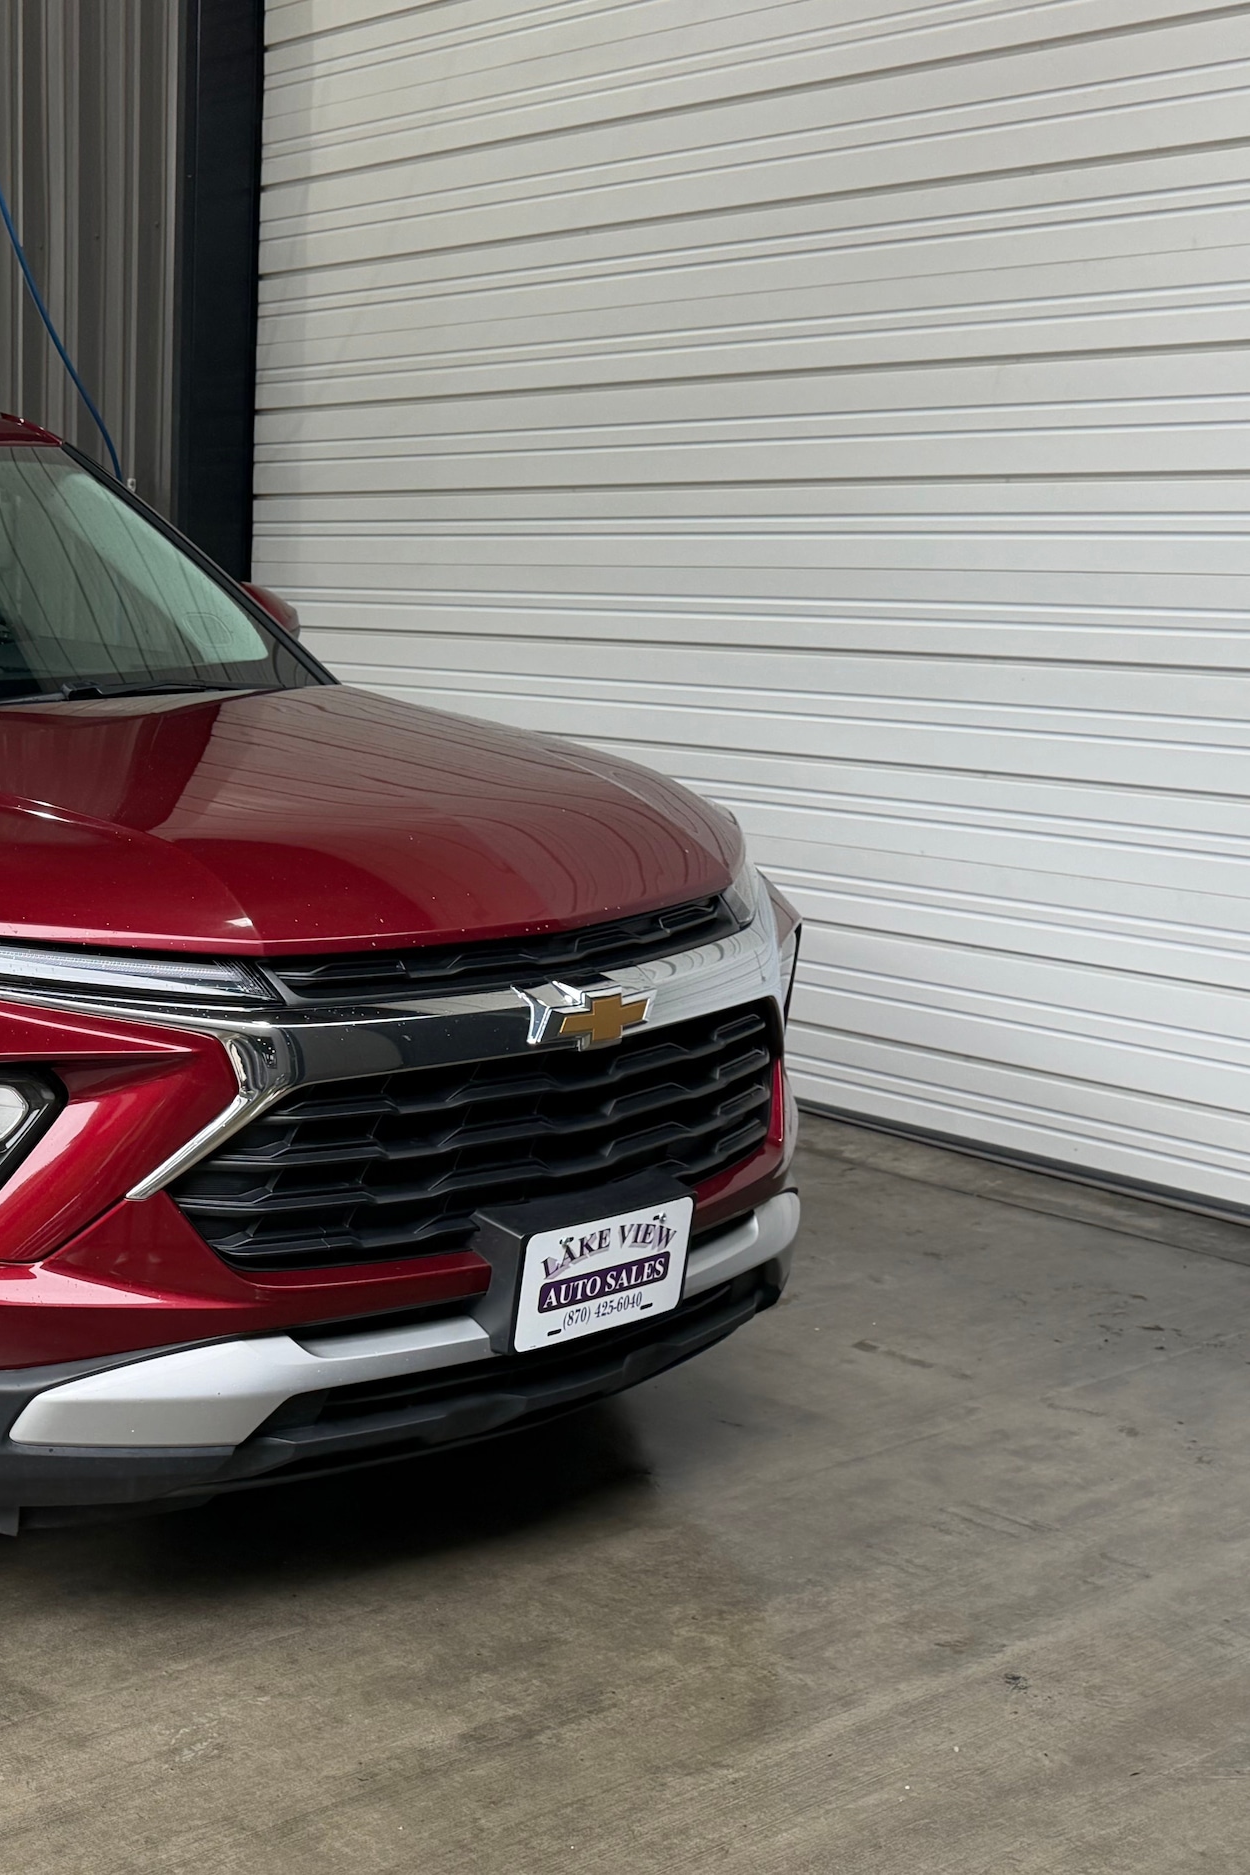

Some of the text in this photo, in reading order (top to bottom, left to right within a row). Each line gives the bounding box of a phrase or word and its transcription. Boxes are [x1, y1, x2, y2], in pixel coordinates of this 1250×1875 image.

[540, 1223, 678, 1280] LAKE VIEW
[542, 1257, 666, 1309] AUTO SALES
[562, 1291, 643, 1331] (870) 425-6040
